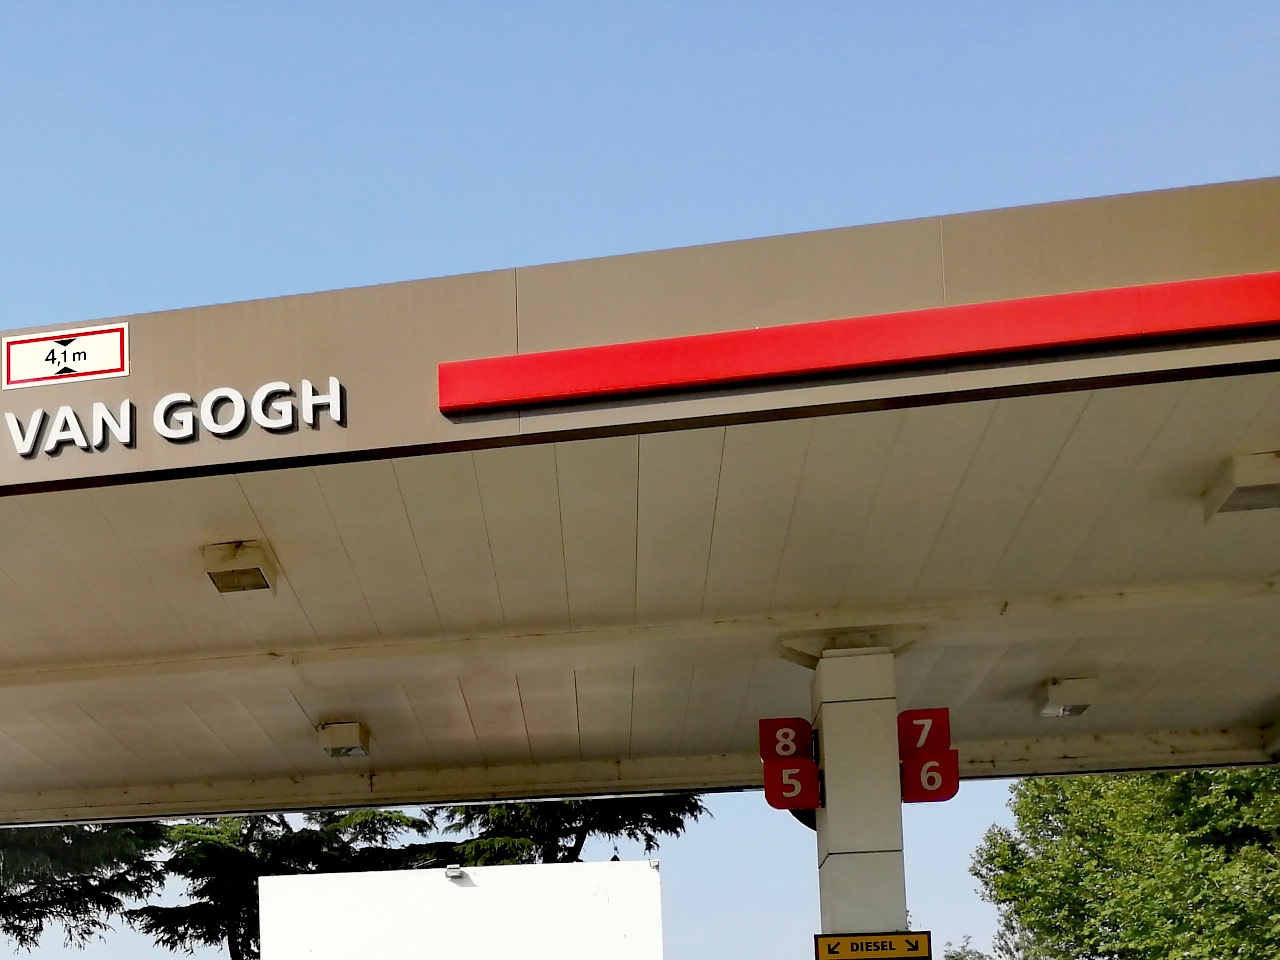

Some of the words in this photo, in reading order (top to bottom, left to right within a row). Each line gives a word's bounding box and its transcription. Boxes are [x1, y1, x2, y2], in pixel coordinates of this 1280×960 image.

[4, 398, 132, 457] VAN
[152, 376, 343, 440] GOGH
[775, 727, 797, 756] 8
[912, 719, 933, 748] 7
[782, 768, 802, 798] 5
[920, 760, 943, 791] 6
[850, 940, 896, 953] DIESEL
